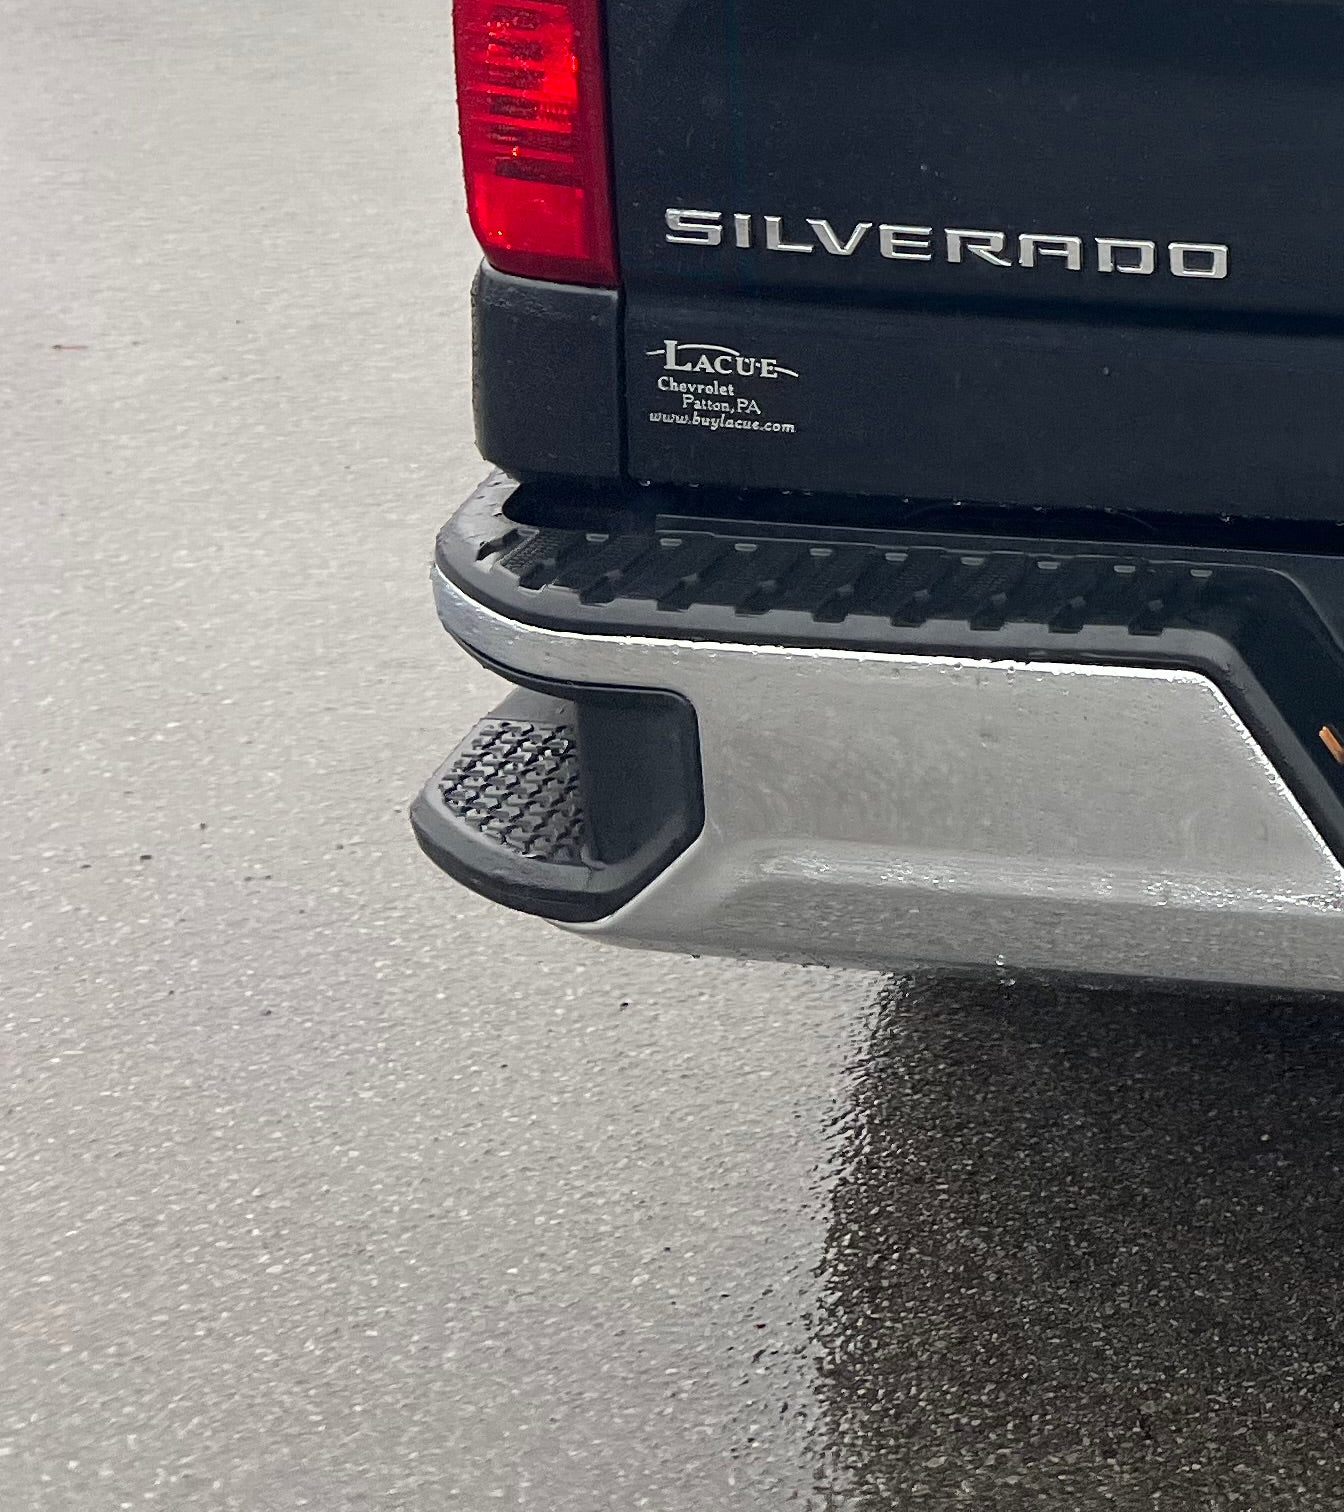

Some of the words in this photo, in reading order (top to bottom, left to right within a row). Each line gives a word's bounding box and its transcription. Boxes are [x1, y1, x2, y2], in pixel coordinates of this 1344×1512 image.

[664, 206, 1231, 280] SILVERADO
[657, 376, 735, 396] Chevrolet
[736, 398, 762, 415] PA
[649, 411, 796, 433] www.buylacue.com
